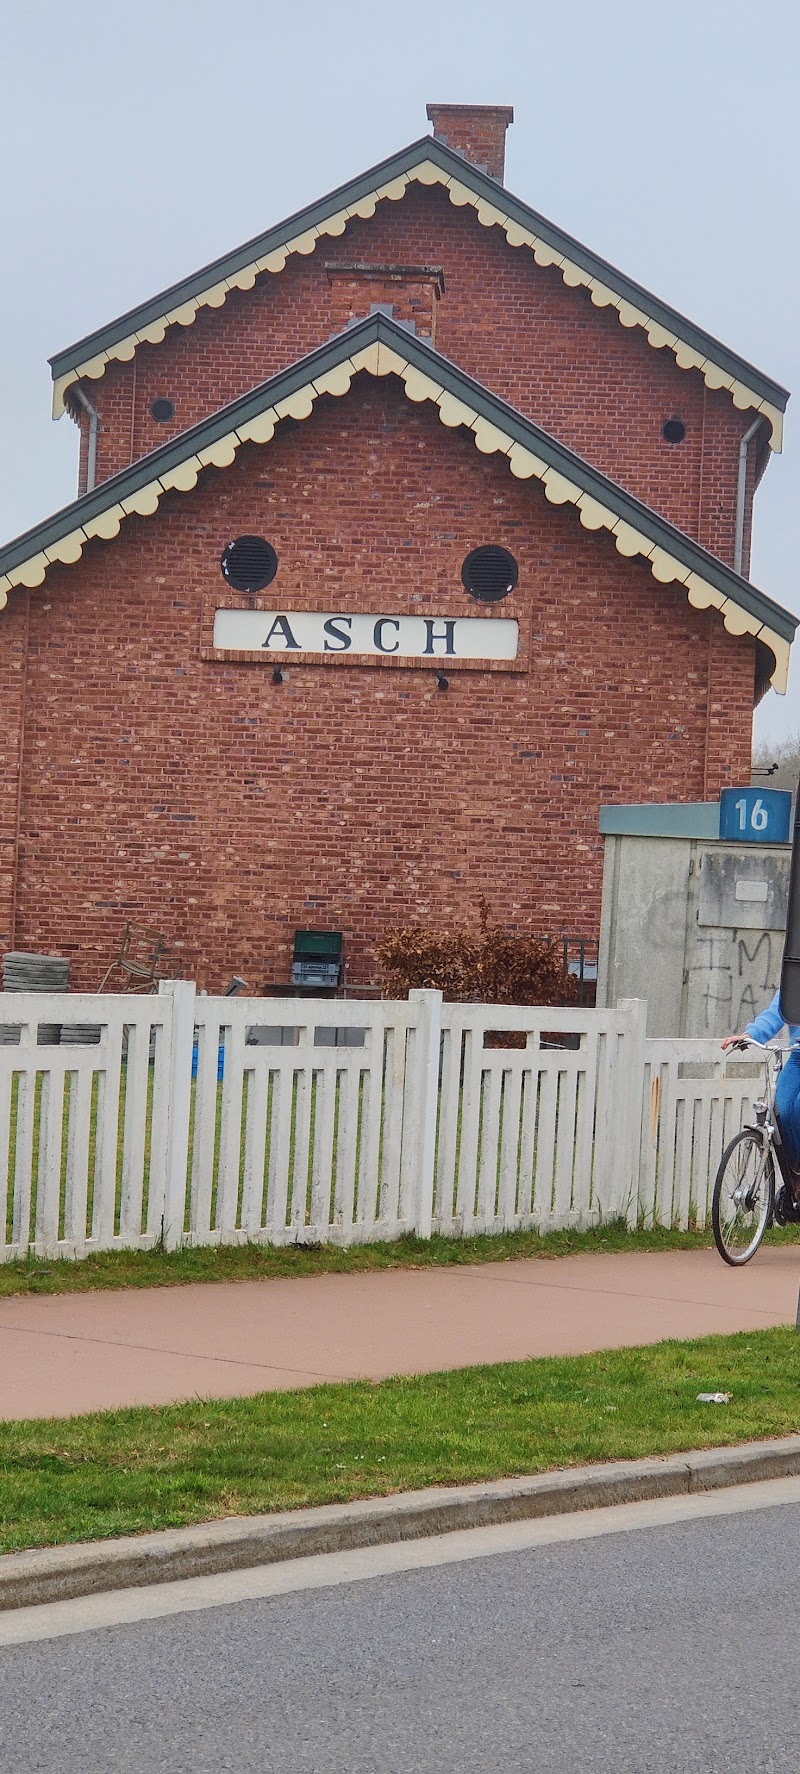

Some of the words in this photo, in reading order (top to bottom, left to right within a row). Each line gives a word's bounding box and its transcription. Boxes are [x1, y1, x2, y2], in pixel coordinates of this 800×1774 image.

[261, 615, 457, 655] ASCH
[735, 798, 768, 831] 16
[691, 928, 772, 991] I'M
